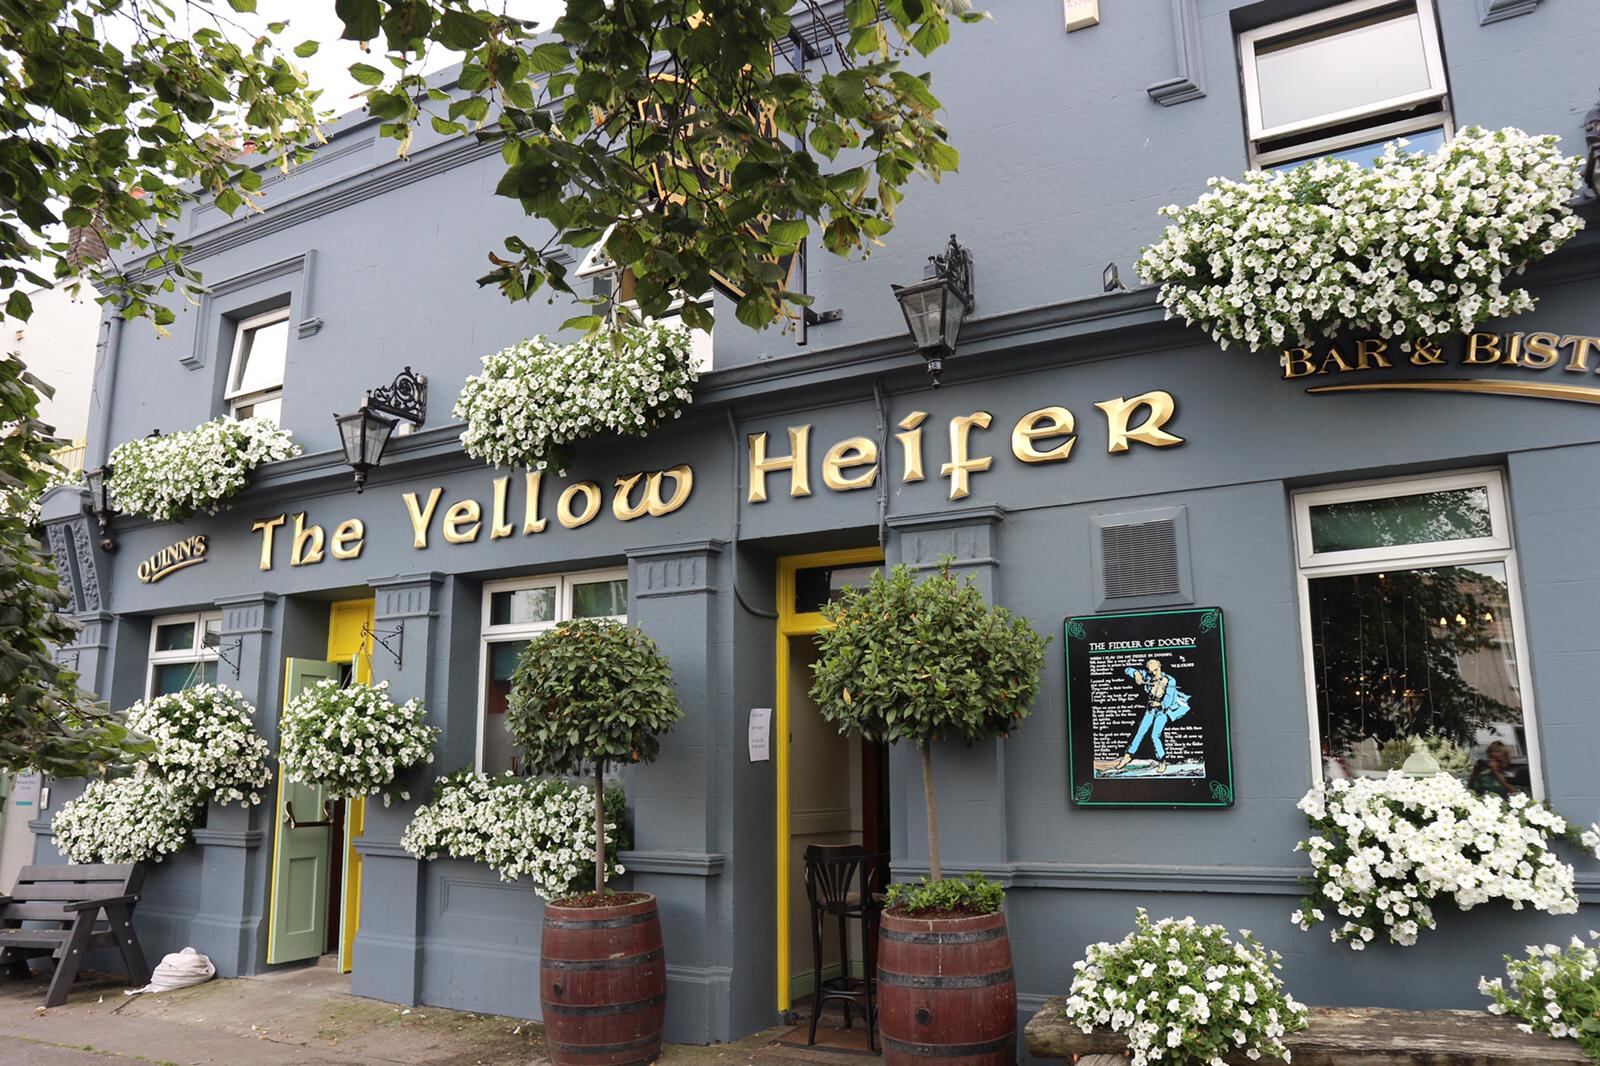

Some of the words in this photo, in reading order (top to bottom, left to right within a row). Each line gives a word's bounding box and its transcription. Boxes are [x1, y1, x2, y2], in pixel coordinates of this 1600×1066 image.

[1283, 338, 1393, 379] BAR
[1410, 336, 1447, 366] &
[1463, 331, 1600, 373] BIST
[251, 511, 366, 571] The
[401, 464, 694, 550] Yellow
[136, 534, 208, 583] QUINN'S
[1089, 642, 1105, 650] THE
[1108, 640, 1142, 649] FIDDLER
[1144, 639, 1155, 648] OF
[1158, 637, 1196, 647] DOONEY
